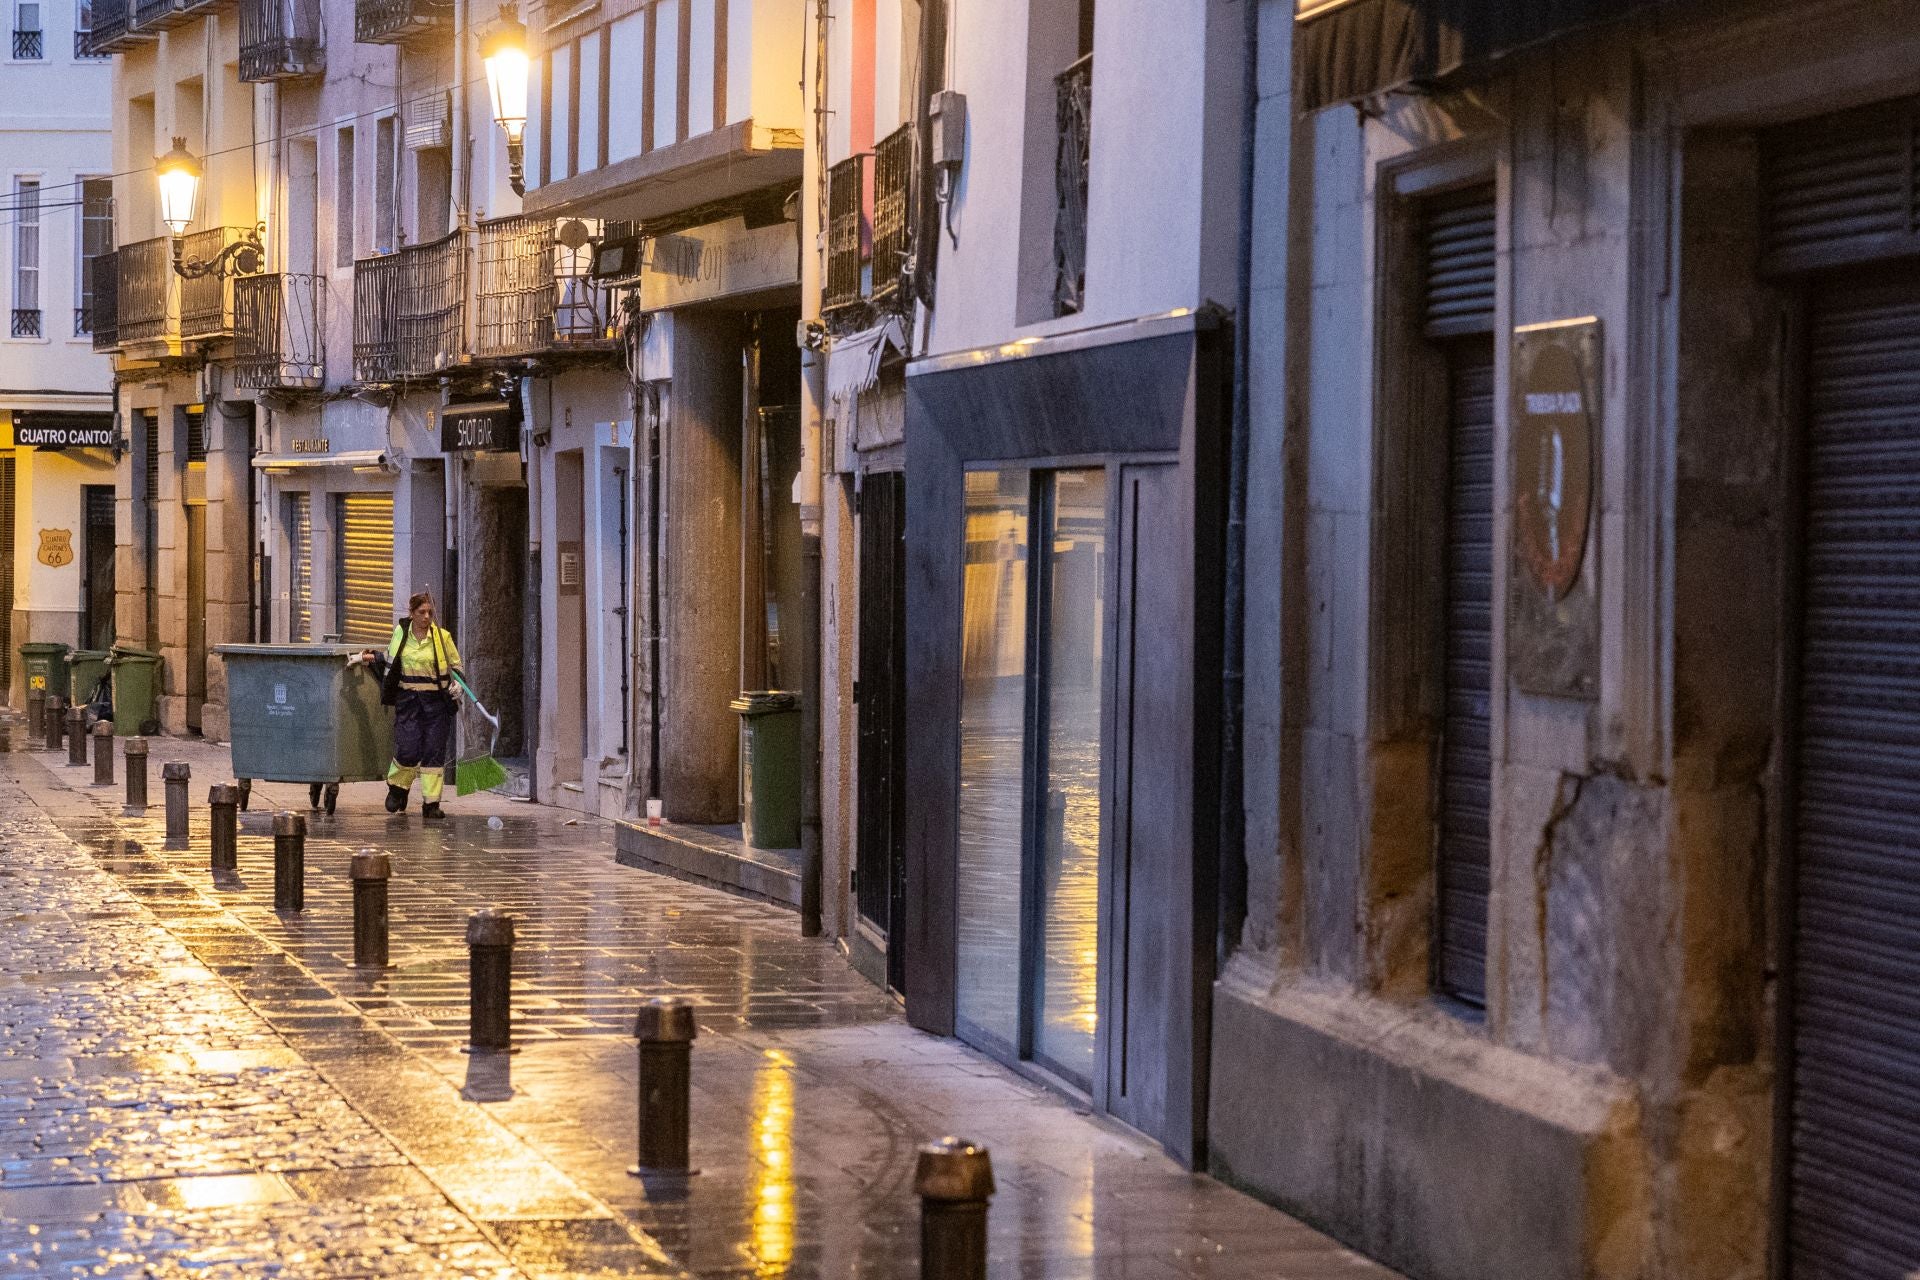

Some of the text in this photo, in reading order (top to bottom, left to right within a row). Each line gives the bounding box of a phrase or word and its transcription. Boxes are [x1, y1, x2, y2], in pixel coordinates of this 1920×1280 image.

[20, 428, 67, 444] CUATRO
[457, 417, 493, 447] SHOT BAR
[47, 552, 62, 564] 66
